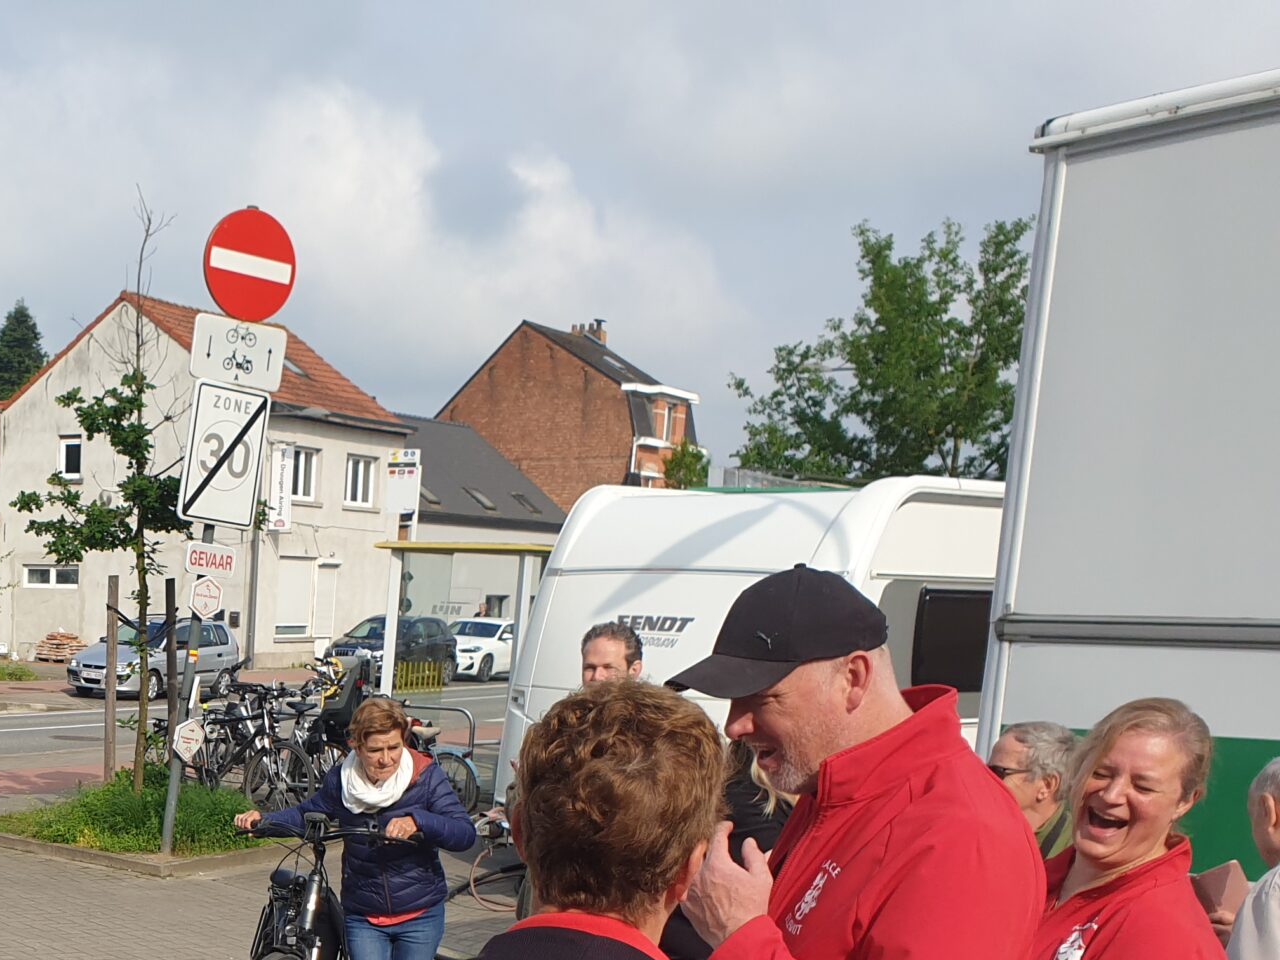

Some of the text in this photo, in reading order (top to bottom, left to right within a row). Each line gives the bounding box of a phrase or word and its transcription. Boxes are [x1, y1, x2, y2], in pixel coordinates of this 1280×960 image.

[213, 395, 252, 415] ZONE
[200, 432, 251, 479] 30
[189, 549, 233, 571] GEVAAR
[617, 614, 695, 633] FENDT
